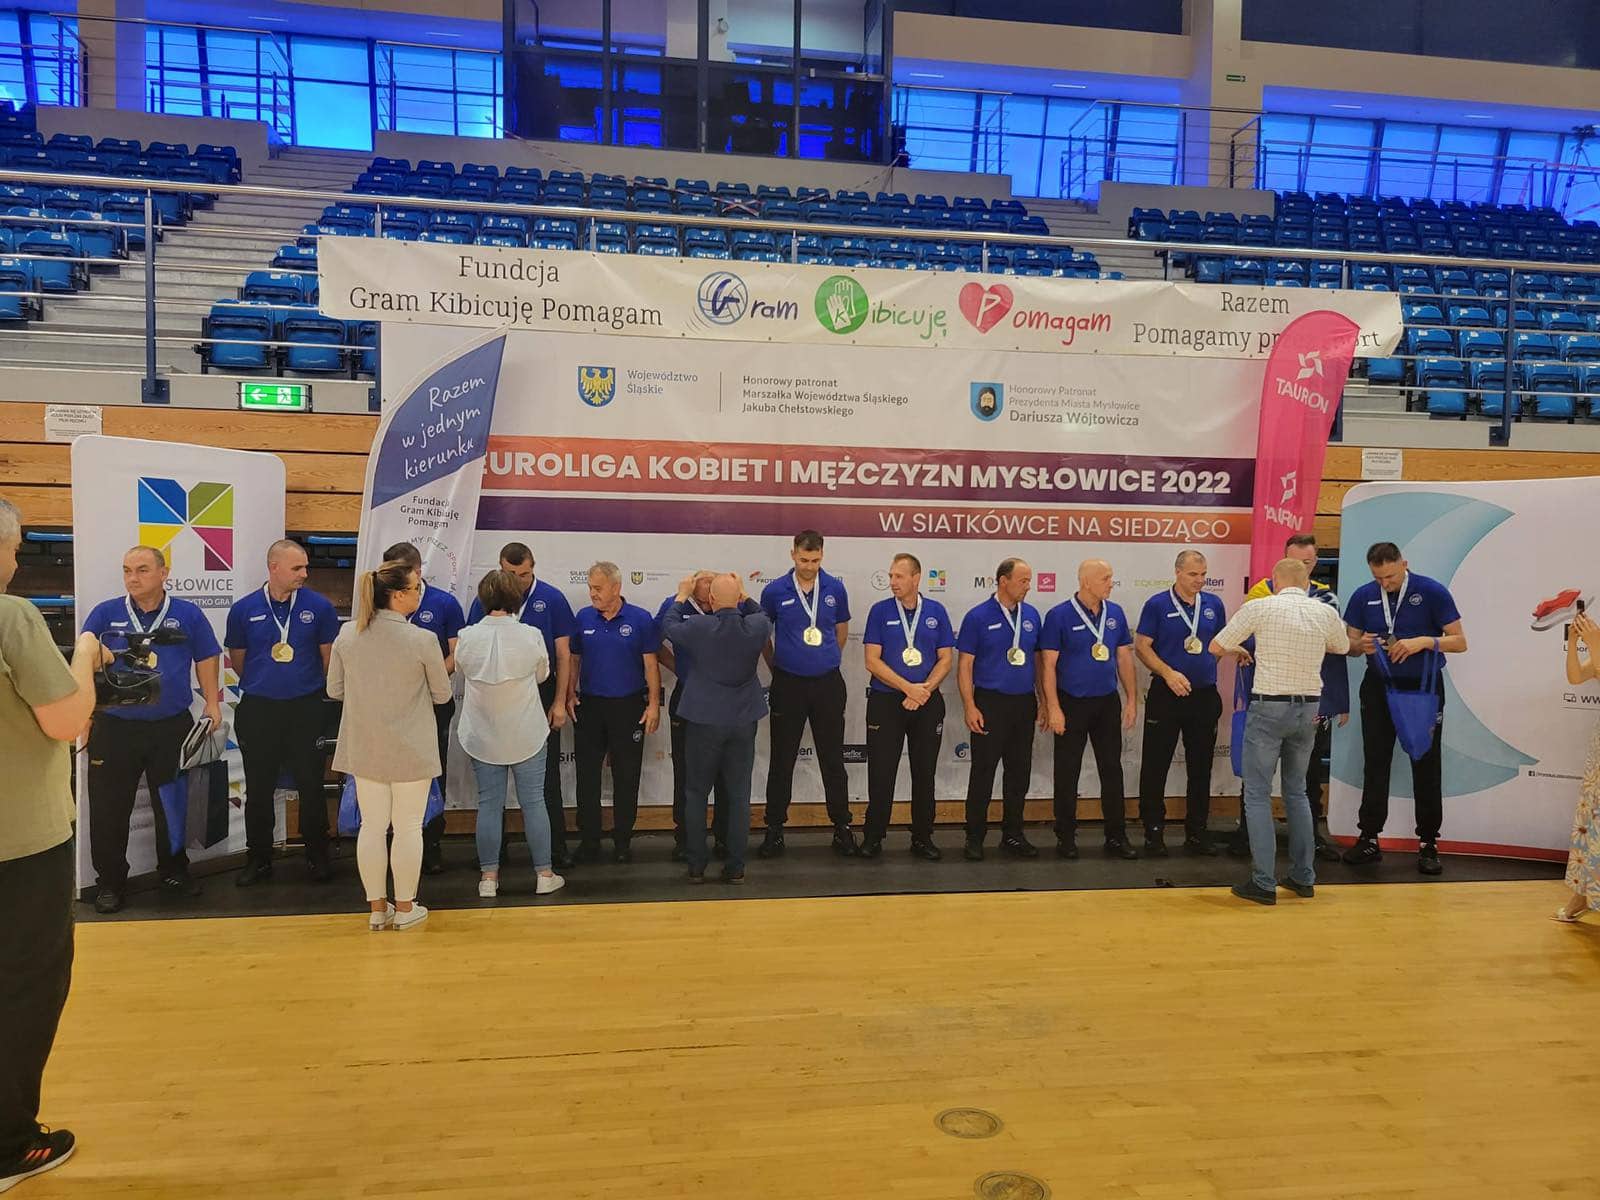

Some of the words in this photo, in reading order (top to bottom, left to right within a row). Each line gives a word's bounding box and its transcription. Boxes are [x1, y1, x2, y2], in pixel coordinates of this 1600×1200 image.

[459, 255, 559, 288] Fundcja
[350, 286, 419, 312] Gram
[429, 290, 534, 324] Kibicuję
[542, 298, 662, 329] Pomagam
[1221, 291, 1290, 314] Razem
[1133, 323, 1251, 351] Pomagamy
[627, 370, 698, 383] Województwo
[743, 376, 792, 388] Honorowy
[795, 377, 838, 389] patronat
[429, 377, 485, 412] Razem
[627, 382, 664, 395] Śląskie
[743, 388, 792, 400] Marszałka
[794, 390, 860, 404] Województwa
[863, 392, 909, 406] Śląskiego
[1009, 384, 1056, 396] Honorowy
[1059, 385, 1096, 396] Patronat
[1276, 377, 1330, 415] TAURON
[742, 402, 776, 413] Jakuba
[778, 403, 854, 417] Chełstowskiego
[1009, 397, 1059, 408] Prezydenta
[1061, 398, 1091, 409] Miasta
[1094, 399, 1140, 411] Mysłowice
[1009, 409, 1063, 423] Dariusza
[1066, 411, 1139, 426] Wójtowicza
[402, 435, 415, 448] w
[421, 408, 480, 449] jednym
[404, 435, 474, 480] kierunku
[649, 455, 768, 483] KOBIET
[775, 459, 783, 483] I
[790, 456, 963, 491] MĘŻCZYZN
[970, 464, 1155, 493] MYSŁOWICE
[1161, 470, 1231, 494] 2022
[412, 495, 449, 507] Fundac
[400, 505, 425, 515] Gram
[427, 508, 460, 520] Kibuję
[878, 512, 905, 532] W
[912, 510, 1059, 535] SIATKÓWCE
[1068, 516, 1102, 536] NA
[1109, 517, 1231, 542] SIEDZĄCO
[166, 578, 234, 592] SŁOWICE
